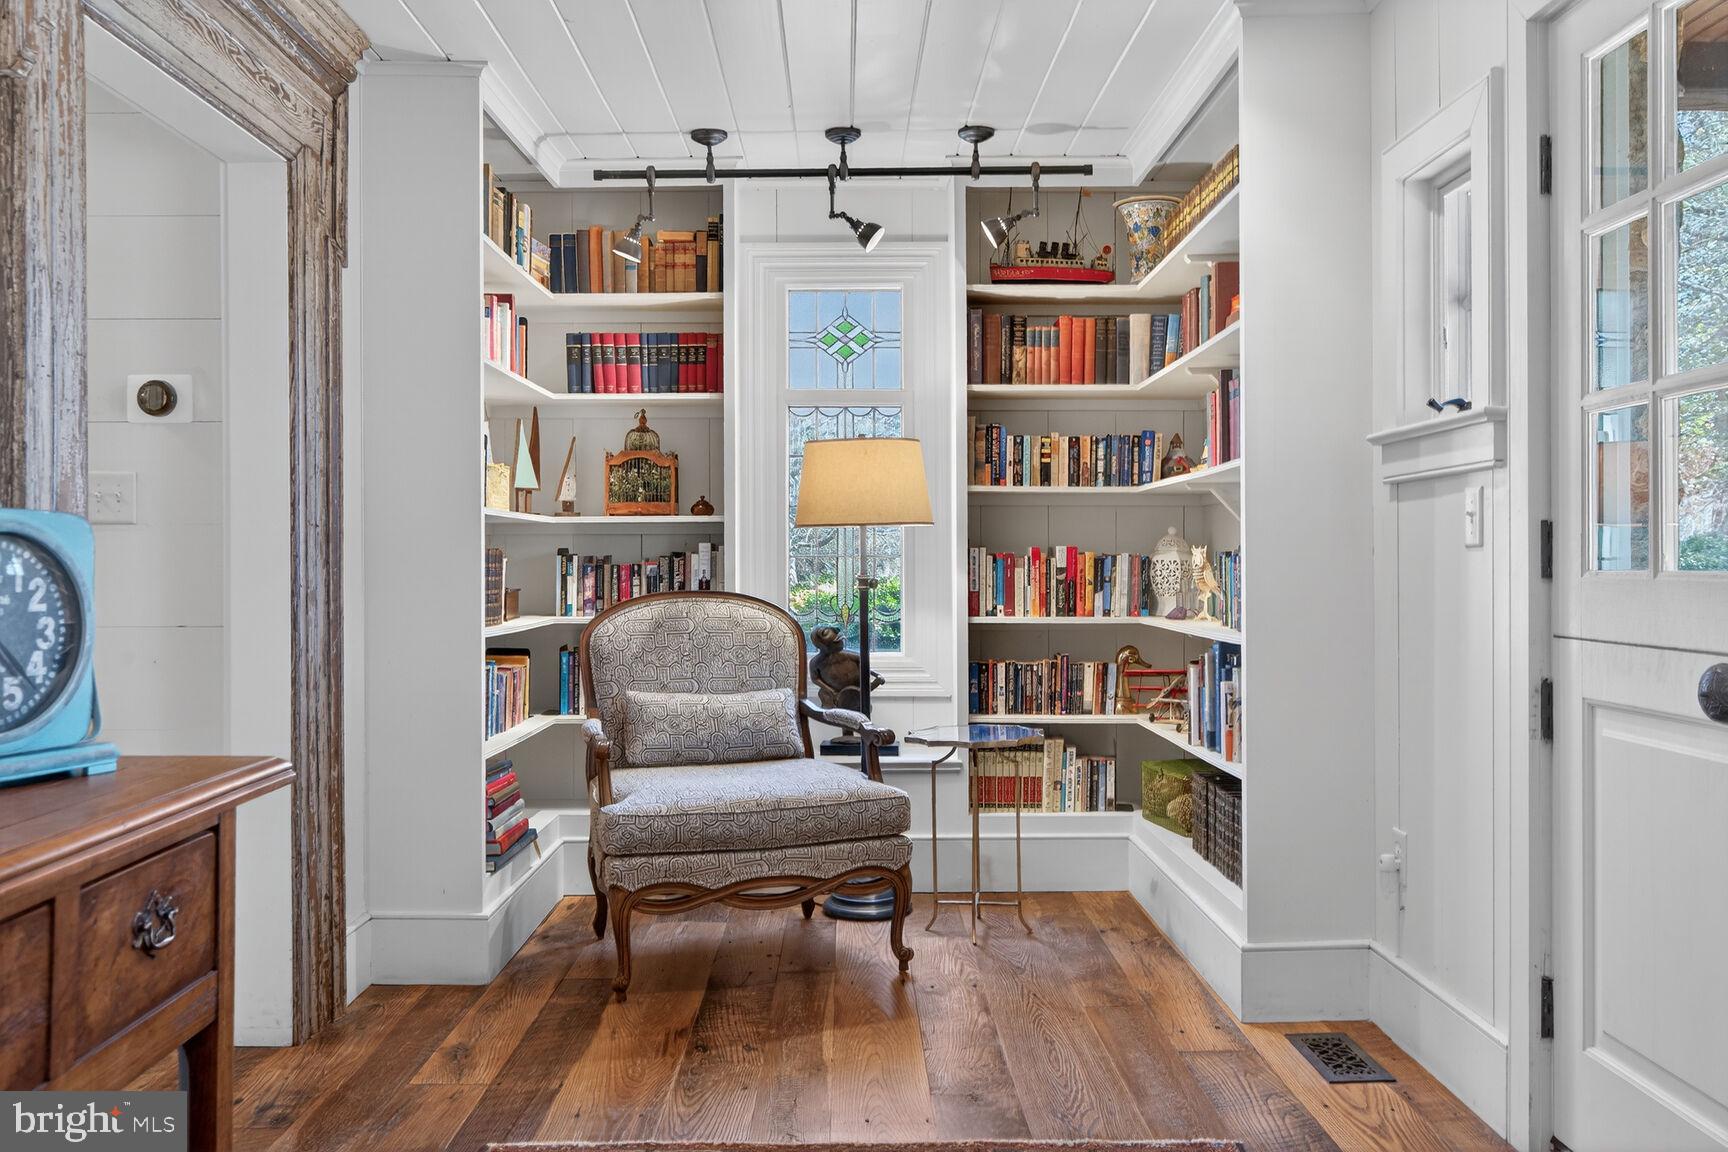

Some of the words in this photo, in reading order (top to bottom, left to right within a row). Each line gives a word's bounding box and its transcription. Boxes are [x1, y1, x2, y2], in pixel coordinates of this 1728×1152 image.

[28, 577, 47, 612] 2
[36, 616, 55, 650] 3
[26, 650, 47, 684] 4
[2, 676, 24, 711] 5
